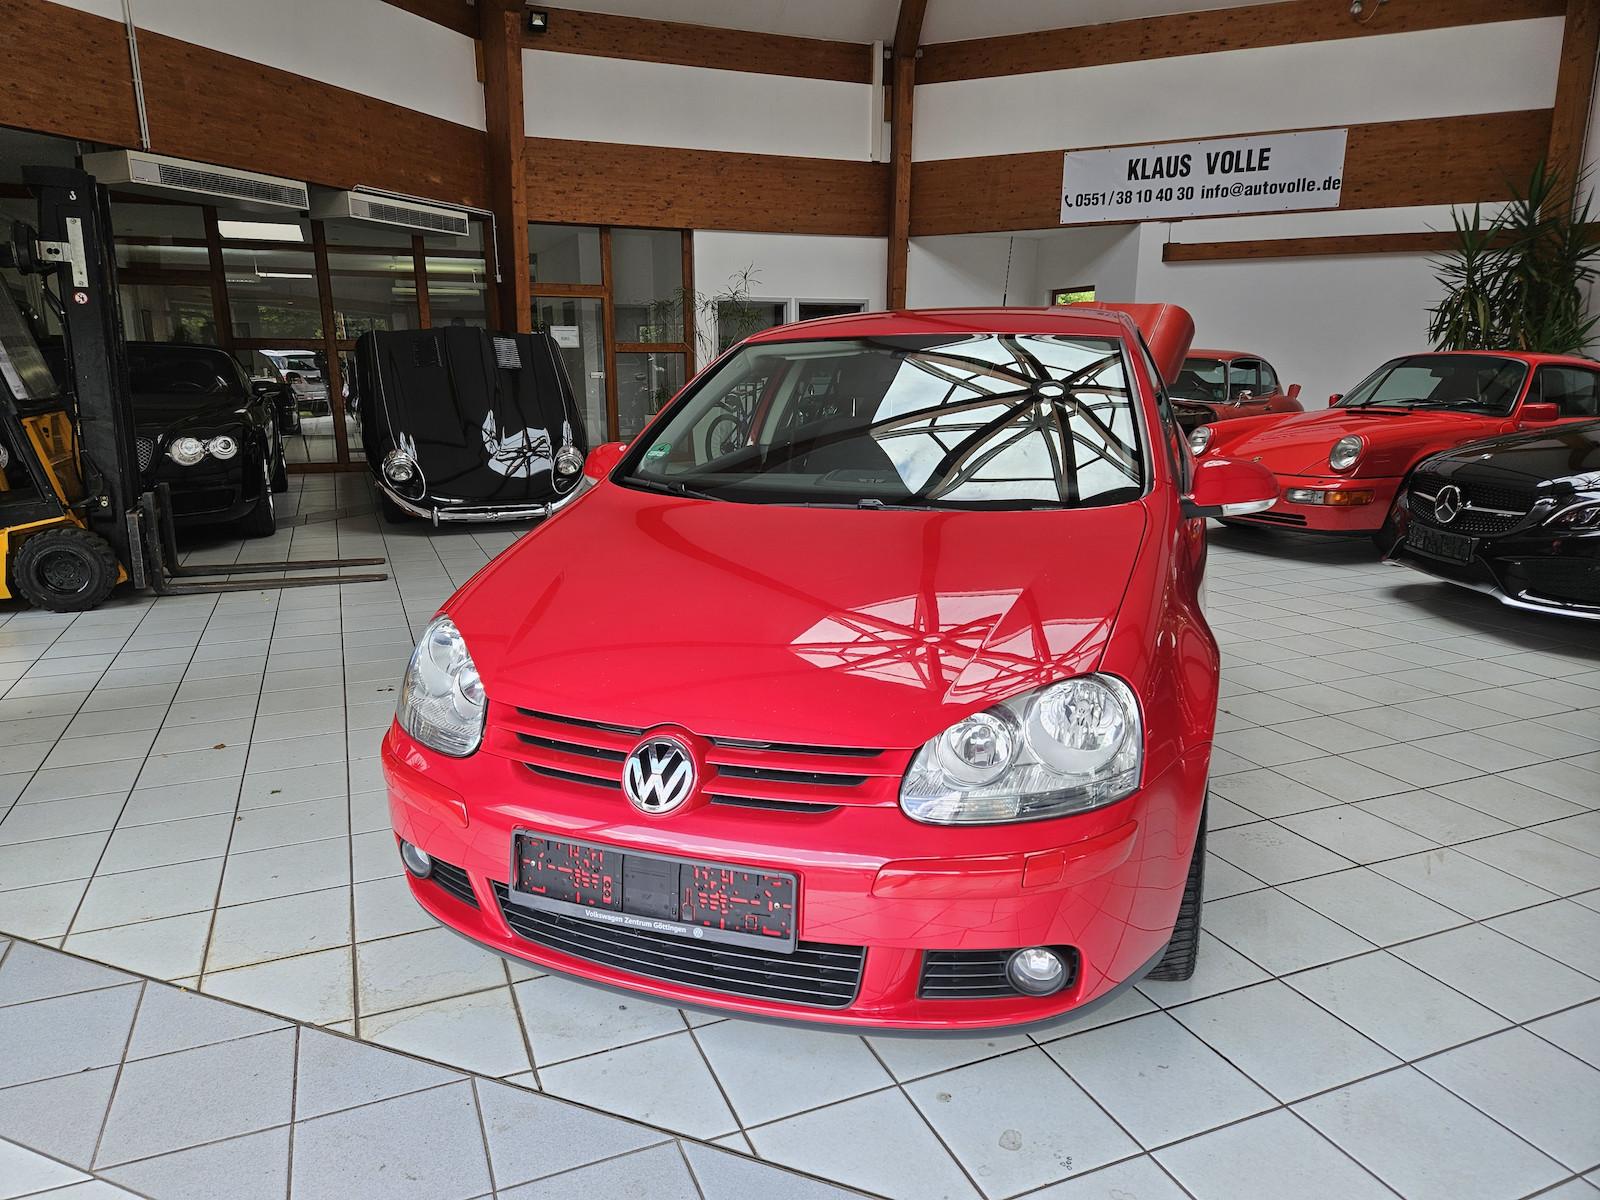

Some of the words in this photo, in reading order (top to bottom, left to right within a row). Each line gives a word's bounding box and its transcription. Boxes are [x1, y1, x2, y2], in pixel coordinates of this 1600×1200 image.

[1127, 154, 1192, 181] KLAUS
[1206, 147, 1271, 175] VOLLE
[1136, 189, 1153, 203] 10
[1155, 187, 1173, 202] 40
[1176, 186, 1194, 200] 30
[1200, 176, 1341, 199] info@autovolle.de
[585, 909, 623, 923] Volkswagen
[624, 916, 652, 928] Zentrum
[653, 921, 687, 934] Göttingen
